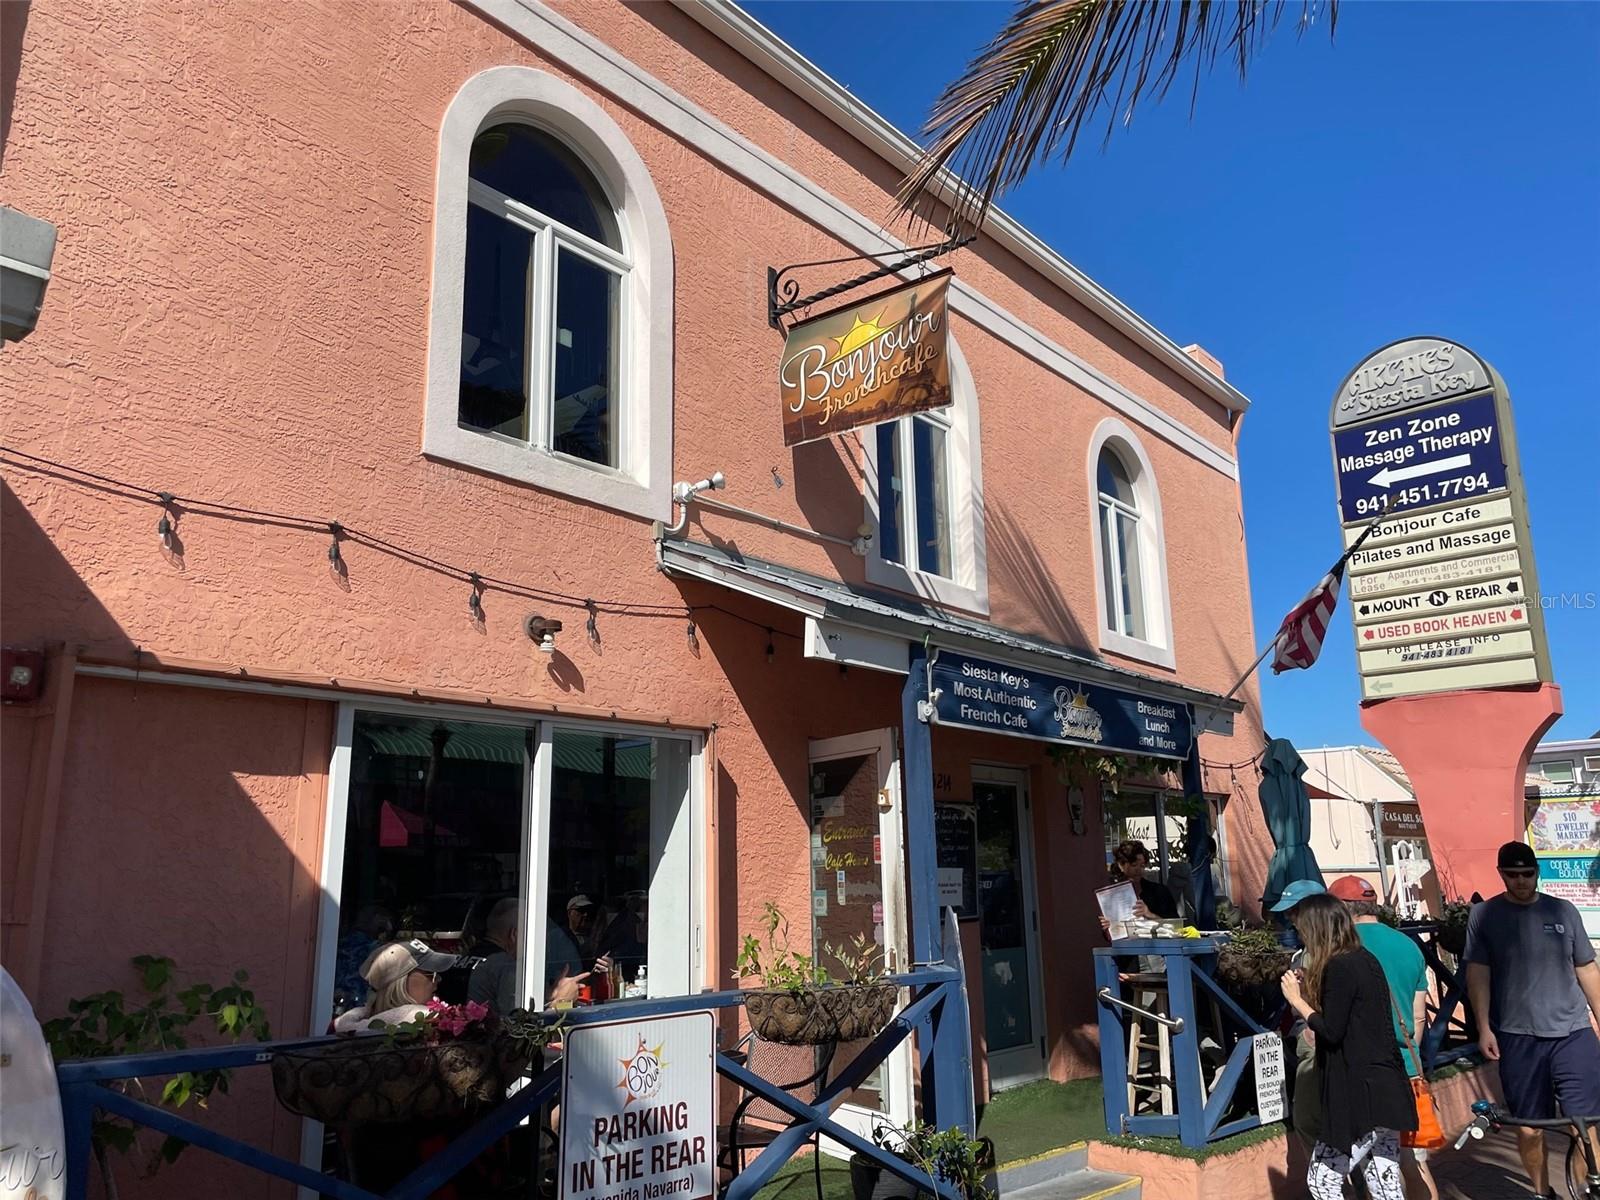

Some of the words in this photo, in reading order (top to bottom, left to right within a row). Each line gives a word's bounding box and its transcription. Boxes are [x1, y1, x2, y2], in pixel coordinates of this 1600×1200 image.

[781, 311, 941, 413] Bonjour
[1355, 384, 1426, 416] Siesta
[1429, 369, 1476, 395] Key
[1364, 426, 1402, 447] Zen
[1407, 412, 1461, 435] Zone
[1340, 443, 1415, 473] Massage
[1418, 425, 1493, 455] Therapy
[1355, 472, 1490, 514] 941.451.7794
[1371, 515, 1437, 538] Bonjour
[1442, 507, 1482, 524] Cafe
[1352, 546, 1402, 565] Pilates
[1406, 540, 1434, 556] and
[1439, 527, 1512, 549] Massage
[1359, 575, 1378, 585] For
[1387, 565, 1439, 582] Apartments
[1440, 561, 1459, 572] and
[1460, 551, 1518, 569] Commercial
[1354, 581, 1386, 594] Lease
[1372, 596, 1421, 614] MOUNT
[1455, 583, 1502, 601] REPAIR
[1378, 623, 1411, 639] USED
[1414, 618, 1450, 635] BOOK
[1453, 611, 1507, 629] HEAVEN
[1386, 644, 1411, 655] FOR
[1419, 638, 1461, 651] LEASE
[1469, 633, 1501, 646] INFO
[961, 662, 999, 682] Siesta
[1000, 671, 1030, 690] Key's
[953, 681, 983, 700] Most
[984, 685, 1037, 711] Authentic
[960, 704, 1001, 725] French
[1003, 711, 1028, 729] Cafe
[1137, 701, 1176, 720] Breakfast
[1145, 718, 1170, 733] Lunch
[1139, 735, 1154, 747] and
[1156, 735, 1176, 750] More
[1384, 812, 1402, 822] CASA
[1403, 813, 1415, 823] DEL
[1555, 822, 1589, 832] JEWELRY
[1563, 811, 1577, 822] $10
[1557, 830, 1590, 841] MARKET
[1255, 1035, 1281, 1051] PARKING
[1259, 1052, 1266, 1064] IN
[1266, 1050, 1279, 1062] THE
[1261, 1065, 1279, 1079] REAR
[594, 1101, 688, 1148] PARKING
[572, 1159, 595, 1194] IN
[602, 1148, 644, 1190] THE
[651, 1135, 705, 1175] REAR
[643, 1172, 694, 1200] Navarra)
